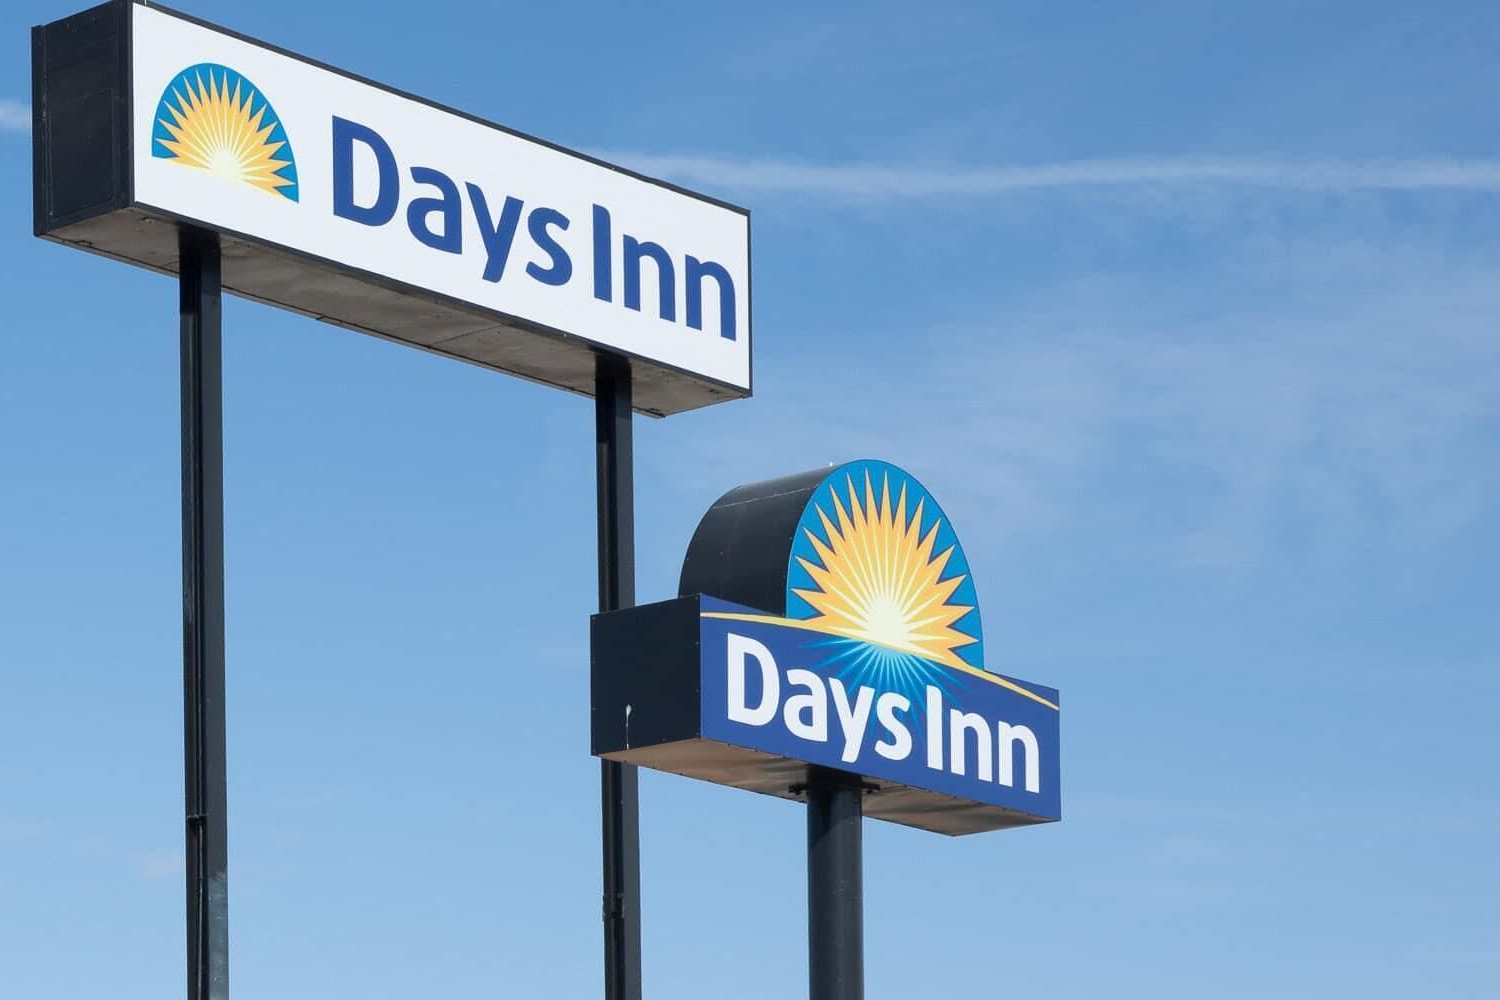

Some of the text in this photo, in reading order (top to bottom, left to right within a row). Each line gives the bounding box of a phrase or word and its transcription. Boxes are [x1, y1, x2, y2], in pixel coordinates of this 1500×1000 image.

[332, 115, 737, 341] Days Inn
[727, 632, 1040, 794] Days Inn
